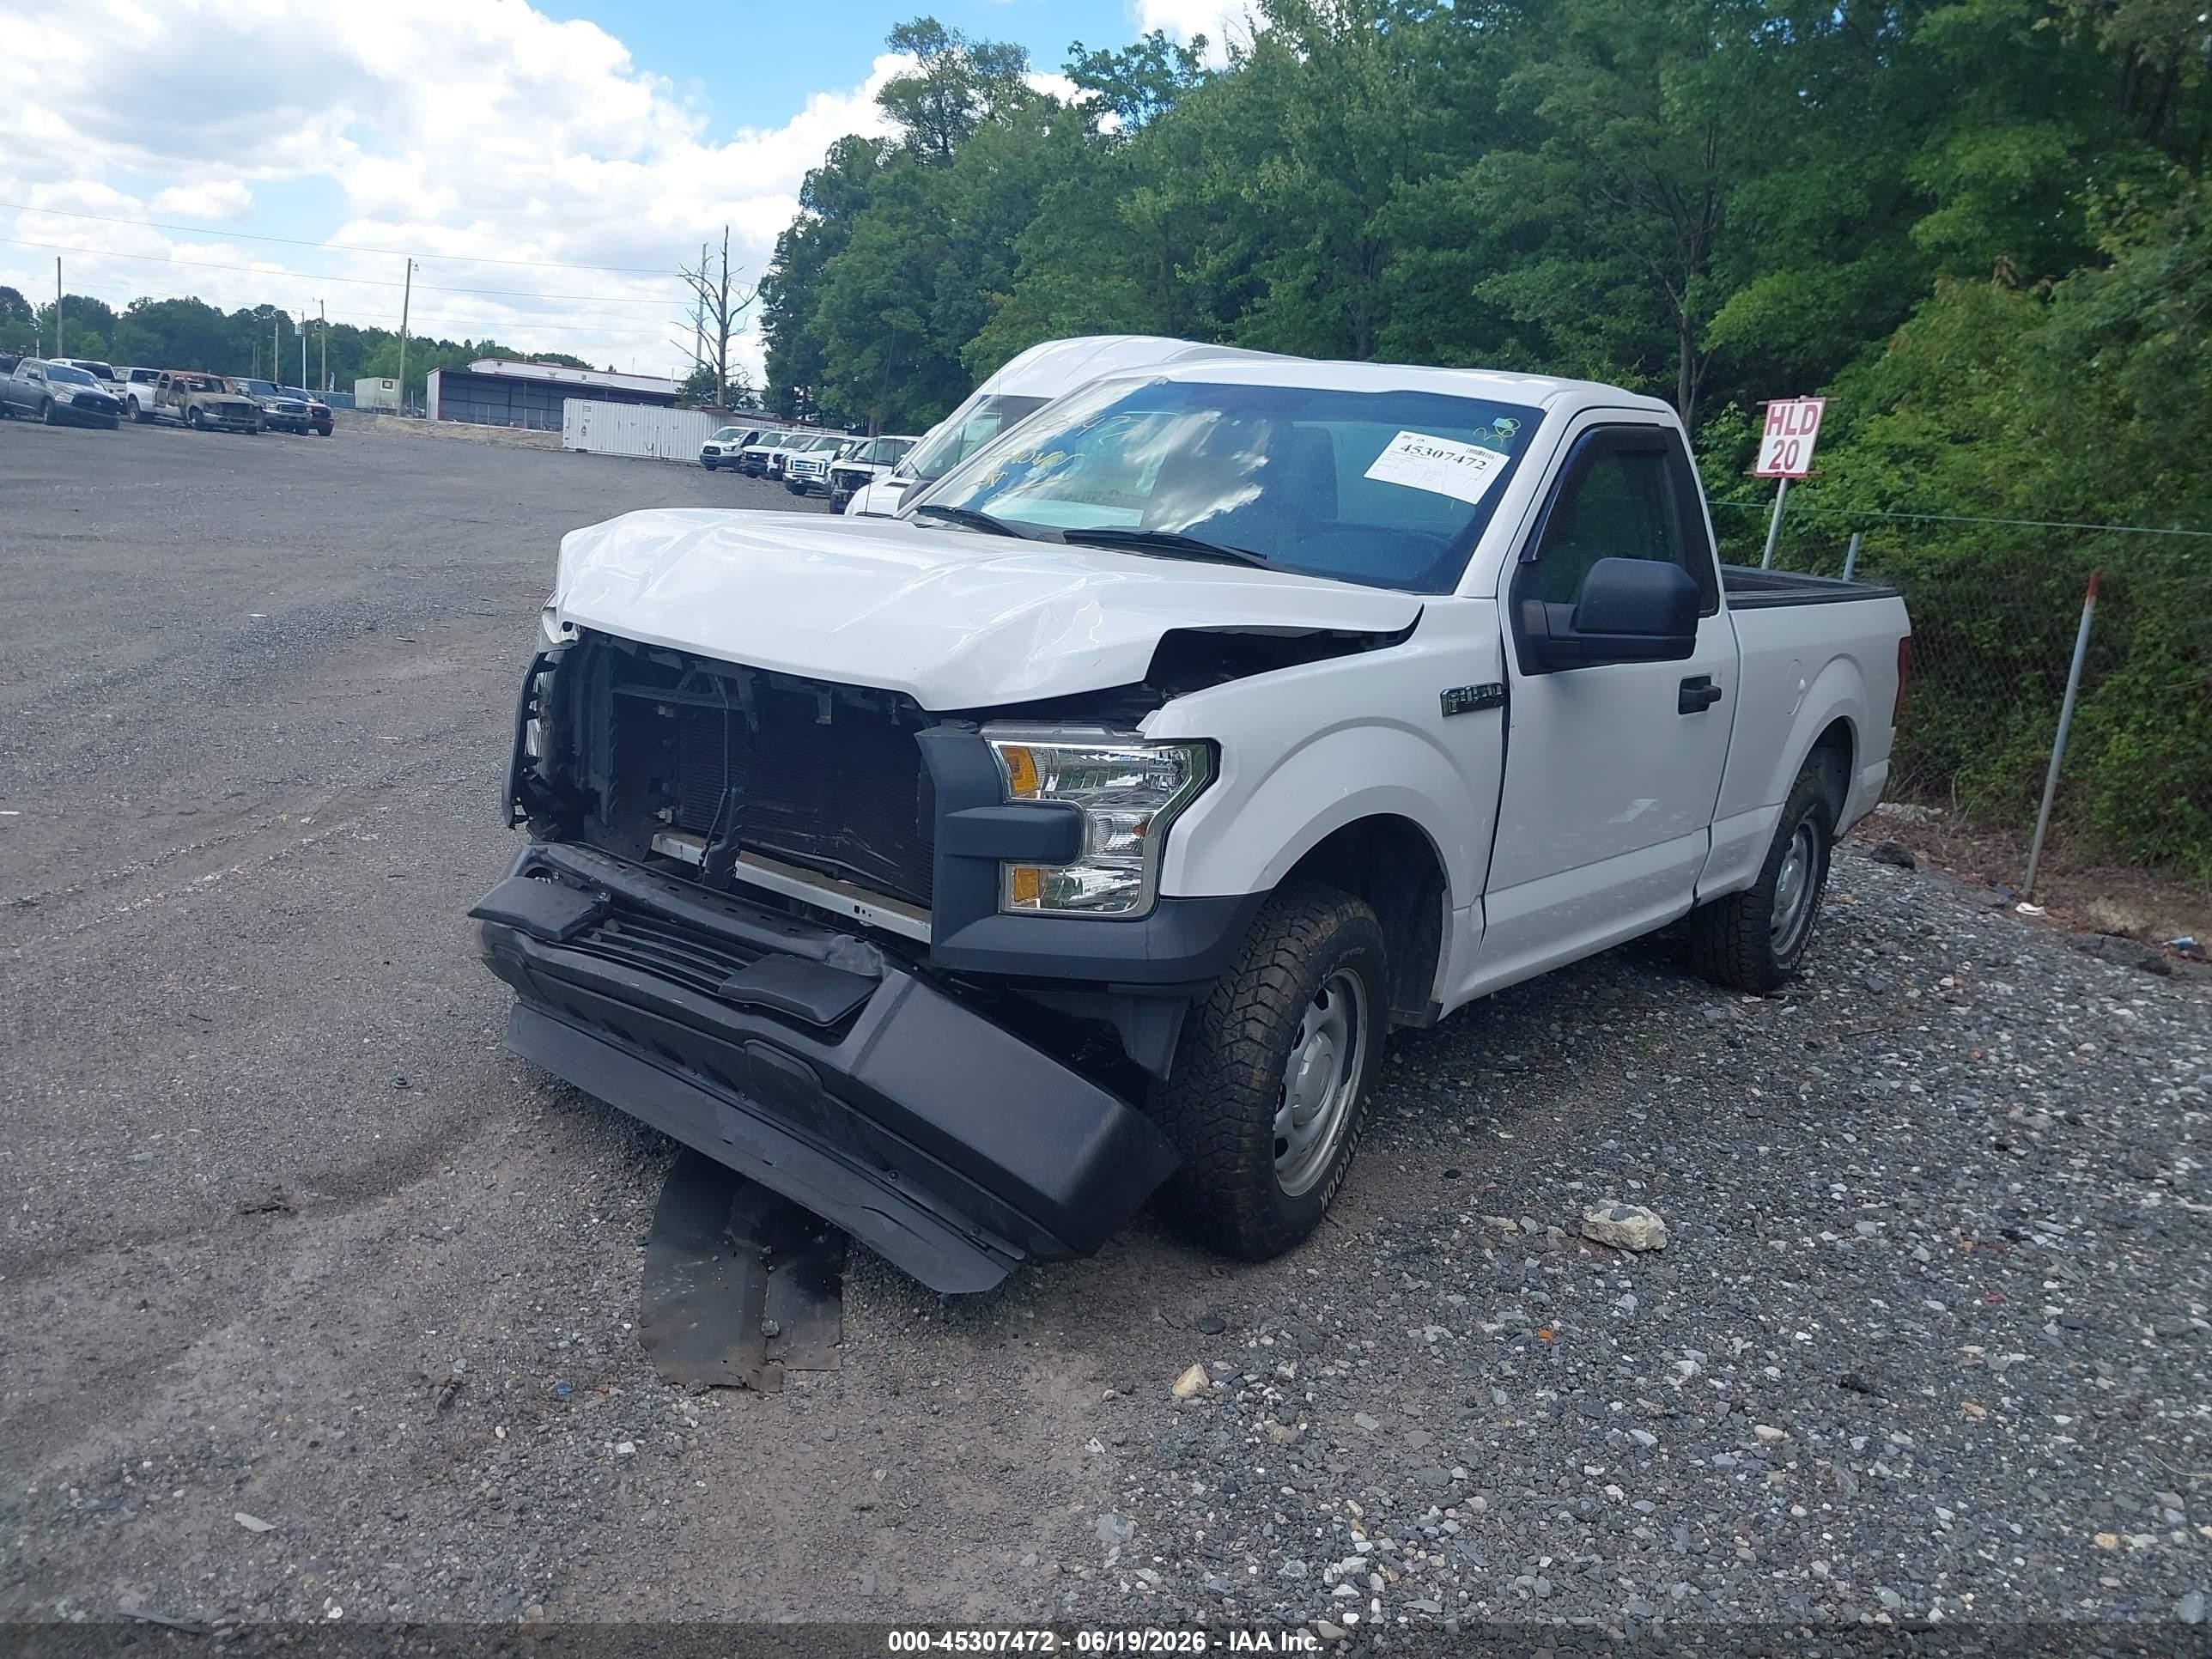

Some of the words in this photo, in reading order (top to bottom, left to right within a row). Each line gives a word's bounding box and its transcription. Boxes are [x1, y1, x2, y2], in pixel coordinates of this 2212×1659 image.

[1765, 404, 1819, 436] HLD
[1400, 443, 1488, 471] 45307472
[1767, 439, 1801, 471] 20
